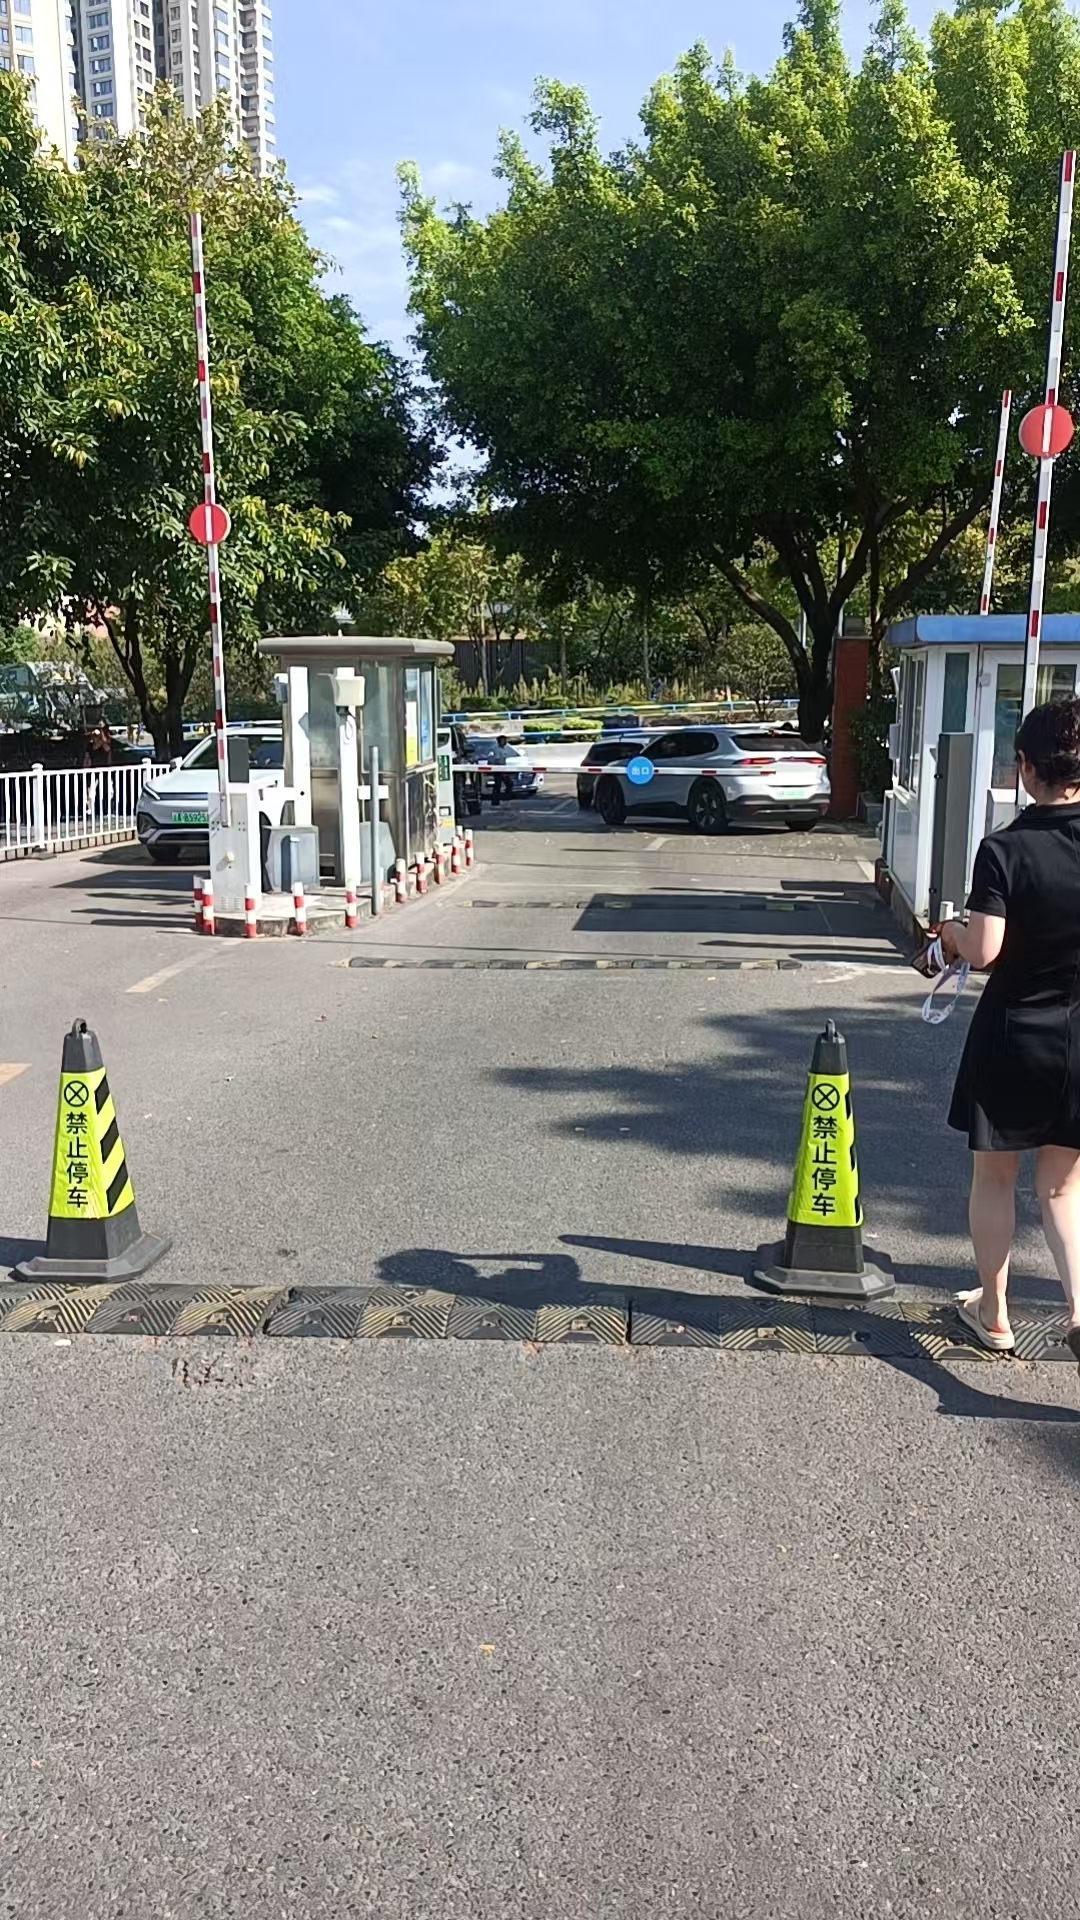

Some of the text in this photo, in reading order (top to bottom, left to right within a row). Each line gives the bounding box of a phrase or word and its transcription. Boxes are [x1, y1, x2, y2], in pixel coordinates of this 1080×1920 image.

[631, 766, 649, 775] 出口
[66, 1111, 89, 1209] 禁止停车
[811, 1115, 837, 1217] 禁止停车
